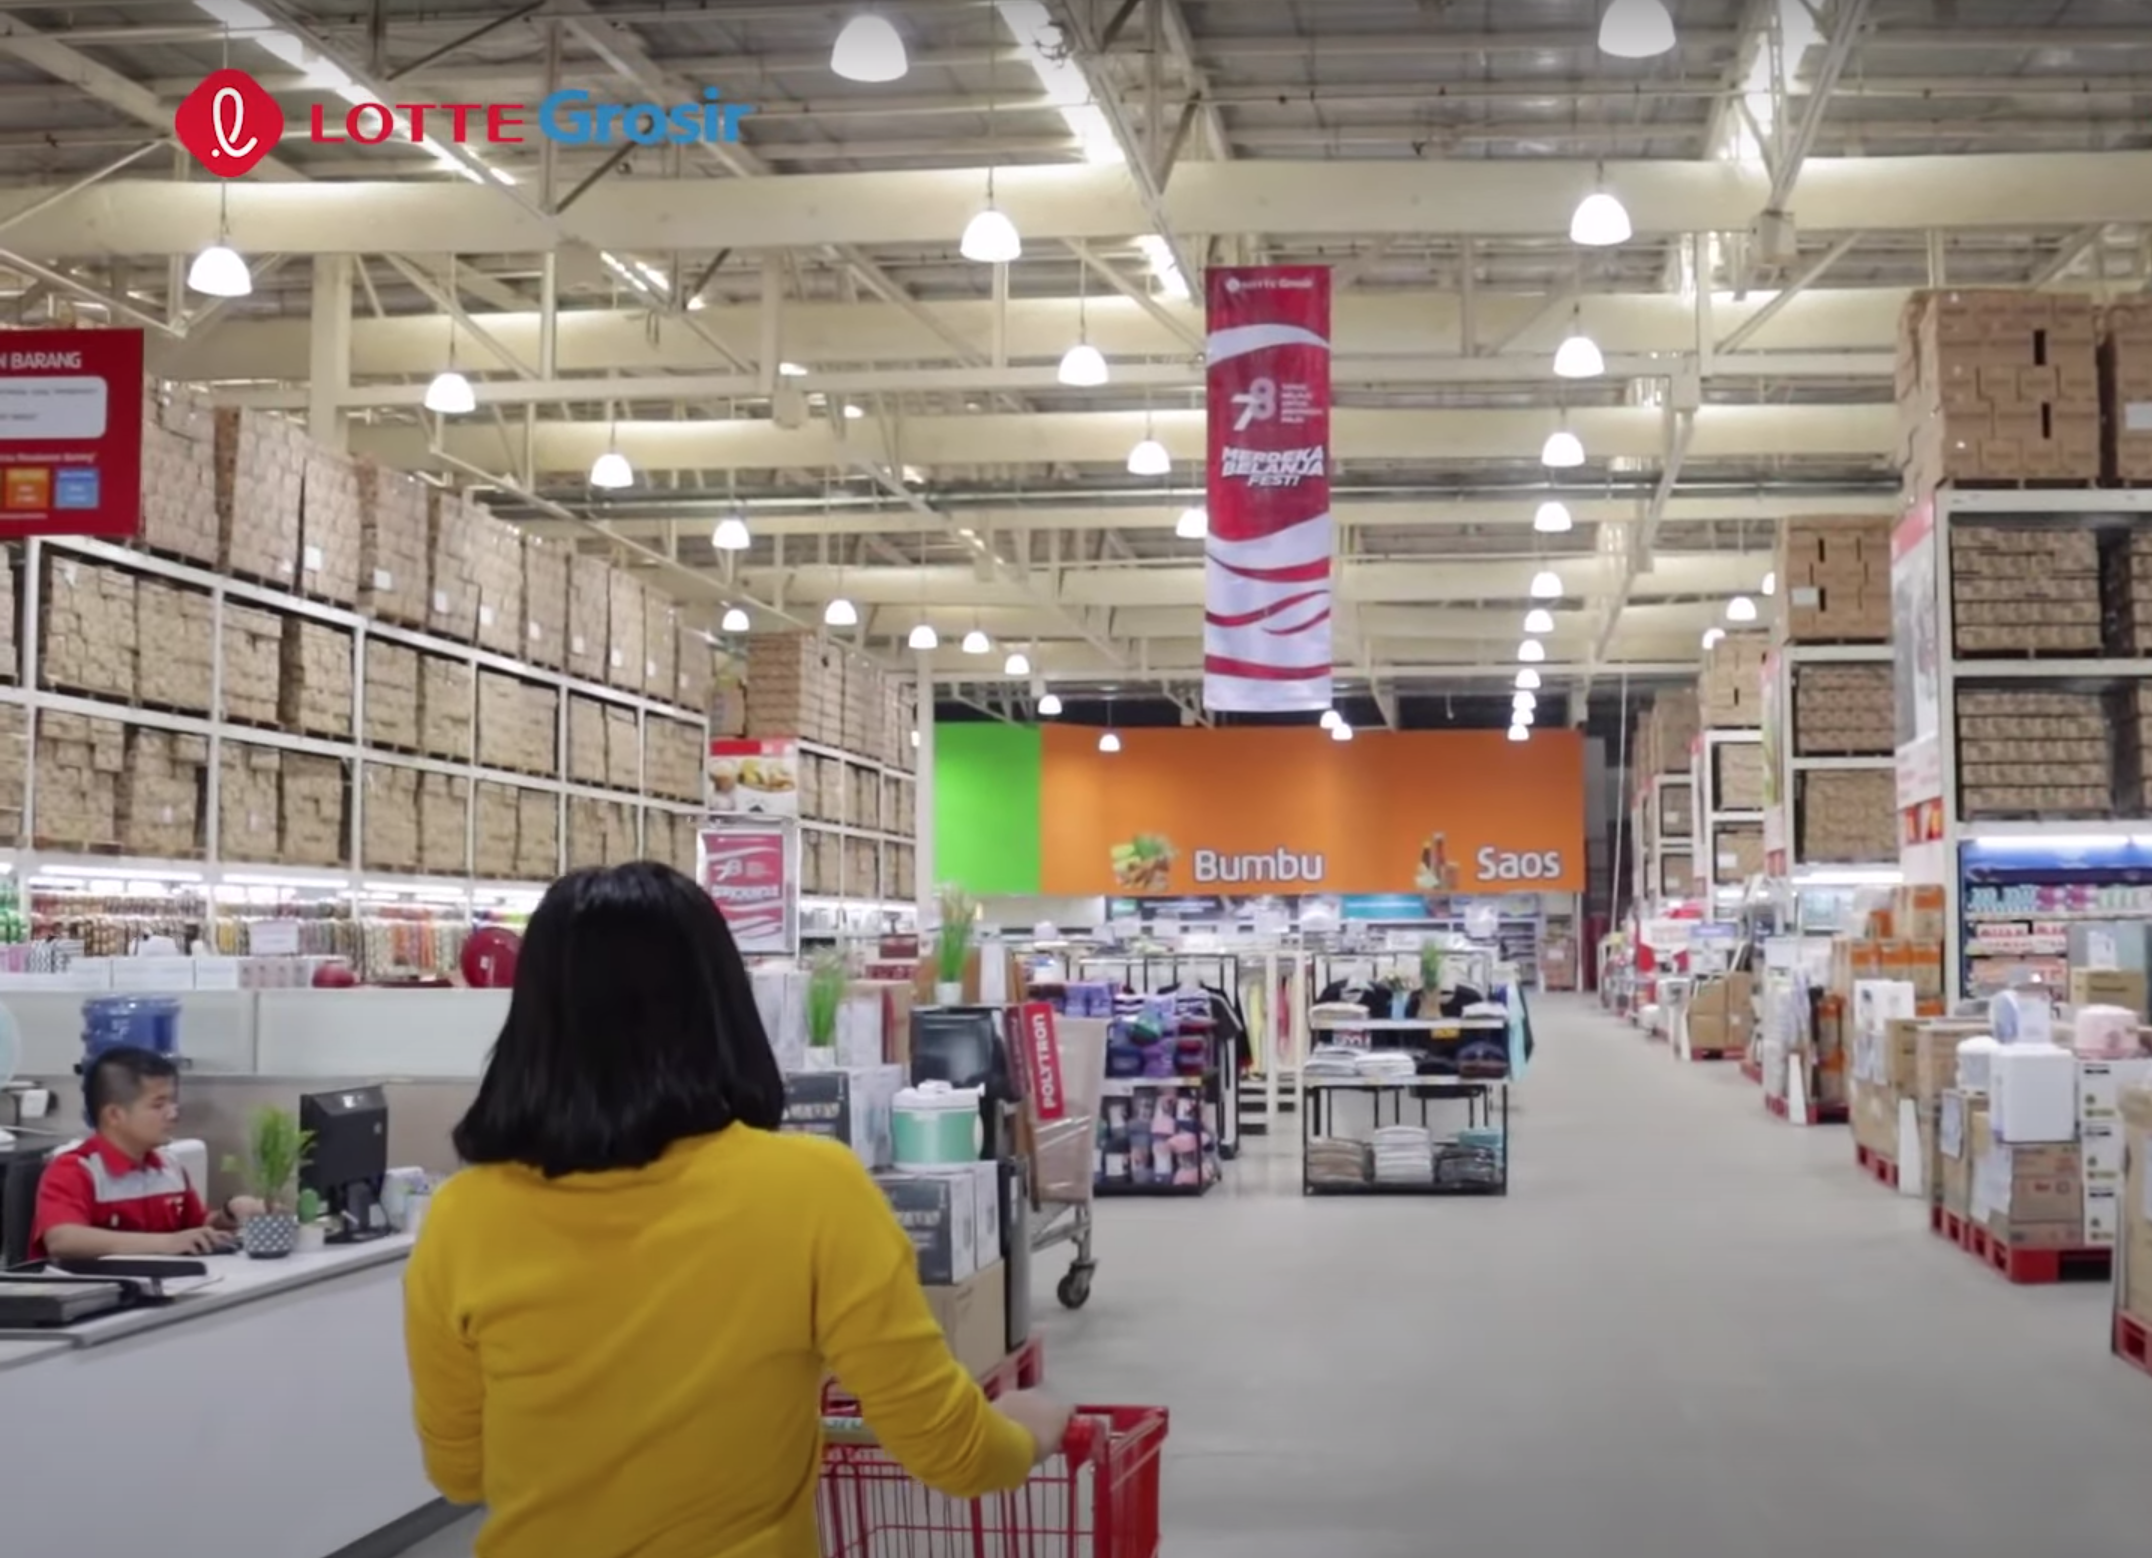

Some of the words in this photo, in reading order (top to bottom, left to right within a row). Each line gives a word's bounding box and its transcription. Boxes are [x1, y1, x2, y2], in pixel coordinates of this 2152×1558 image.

[11, 350, 82, 370] BARANG
[1193, 847, 1324, 882] Bumbu
[1476, 846, 1561, 880] Saos
[1031, 1013, 1058, 1110] POLYTRON
